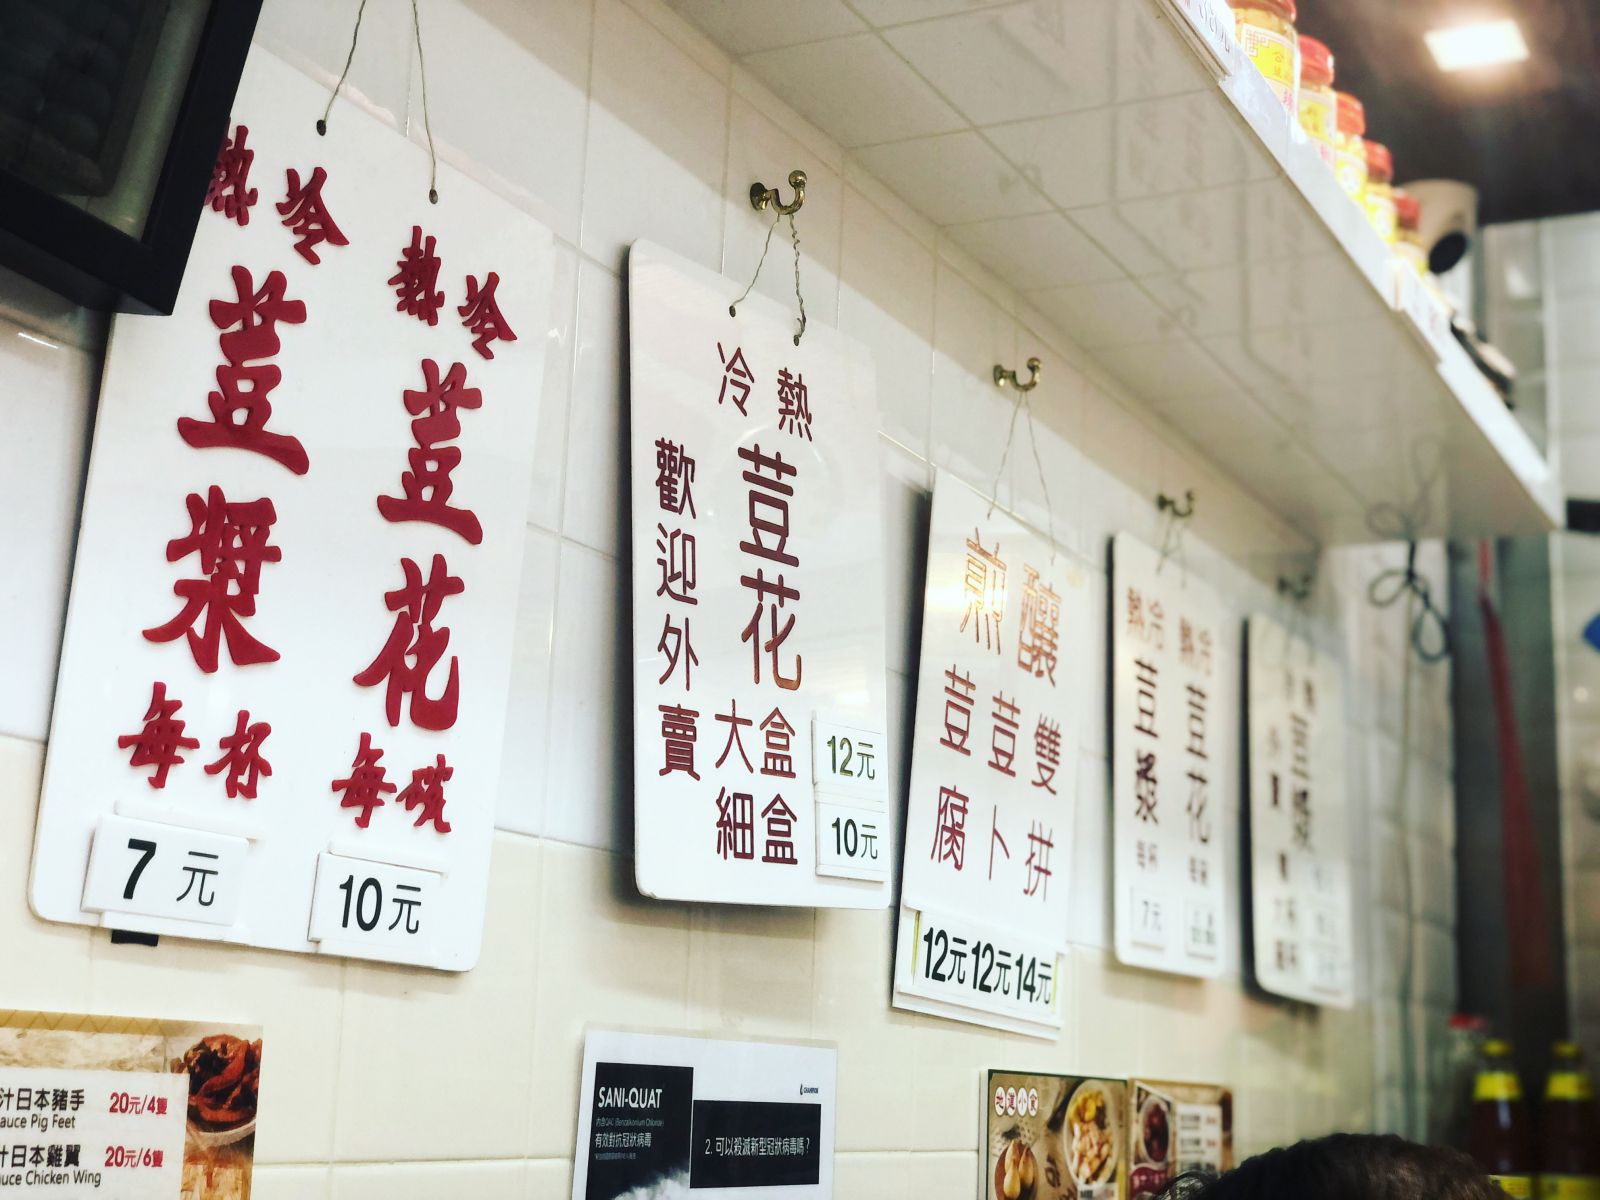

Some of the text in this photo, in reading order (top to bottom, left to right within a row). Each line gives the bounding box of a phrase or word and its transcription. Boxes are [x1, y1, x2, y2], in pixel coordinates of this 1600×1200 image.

[737, 443, 802, 691] 荳花
[655, 437, 701, 782] 歡迎外賣
[118, 682, 272, 799] 每杯
[714, 698, 797, 779] 大盒
[826, 734, 876, 781] 12元
[715, 785, 799, 866] 細盒
[831, 816, 879, 860] 10元
[338, 874, 422, 935] 10元
[0, 1113, 76, 1132] auce Pig Feet
[598, 1086, 663, 1108] SANI-QUAT
[0, 1170, 101, 1188] uce Chicken Wing
